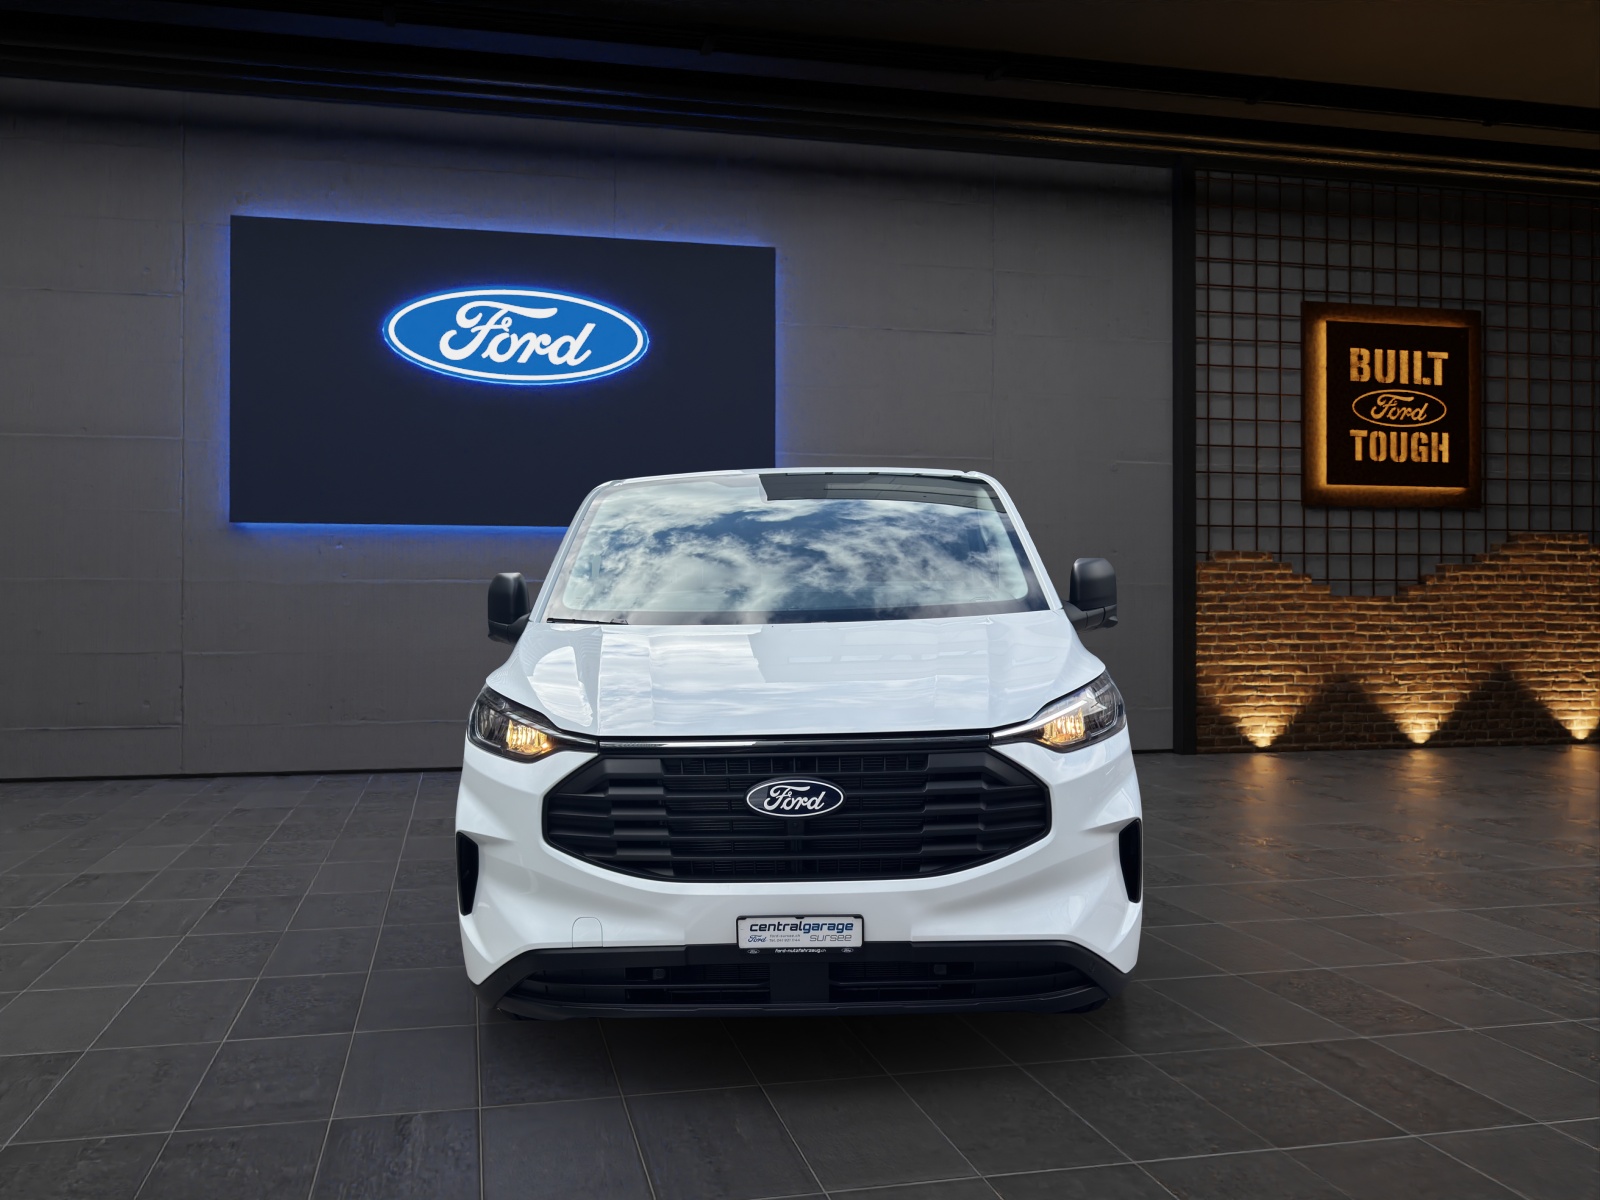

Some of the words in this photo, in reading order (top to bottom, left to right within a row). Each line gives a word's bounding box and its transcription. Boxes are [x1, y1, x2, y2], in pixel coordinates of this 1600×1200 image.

[439, 300, 596, 366] Ford
[1349, 347, 1449, 386] BUILT
[1370, 394, 1428, 421] Ford
[1349, 429, 1450, 463] TOUGH
[763, 785, 826, 811] Ford
[747, 934, 767, 943] Ford
[749, 921, 854, 934] centralgarage
[809, 934, 853, 942] sursee
